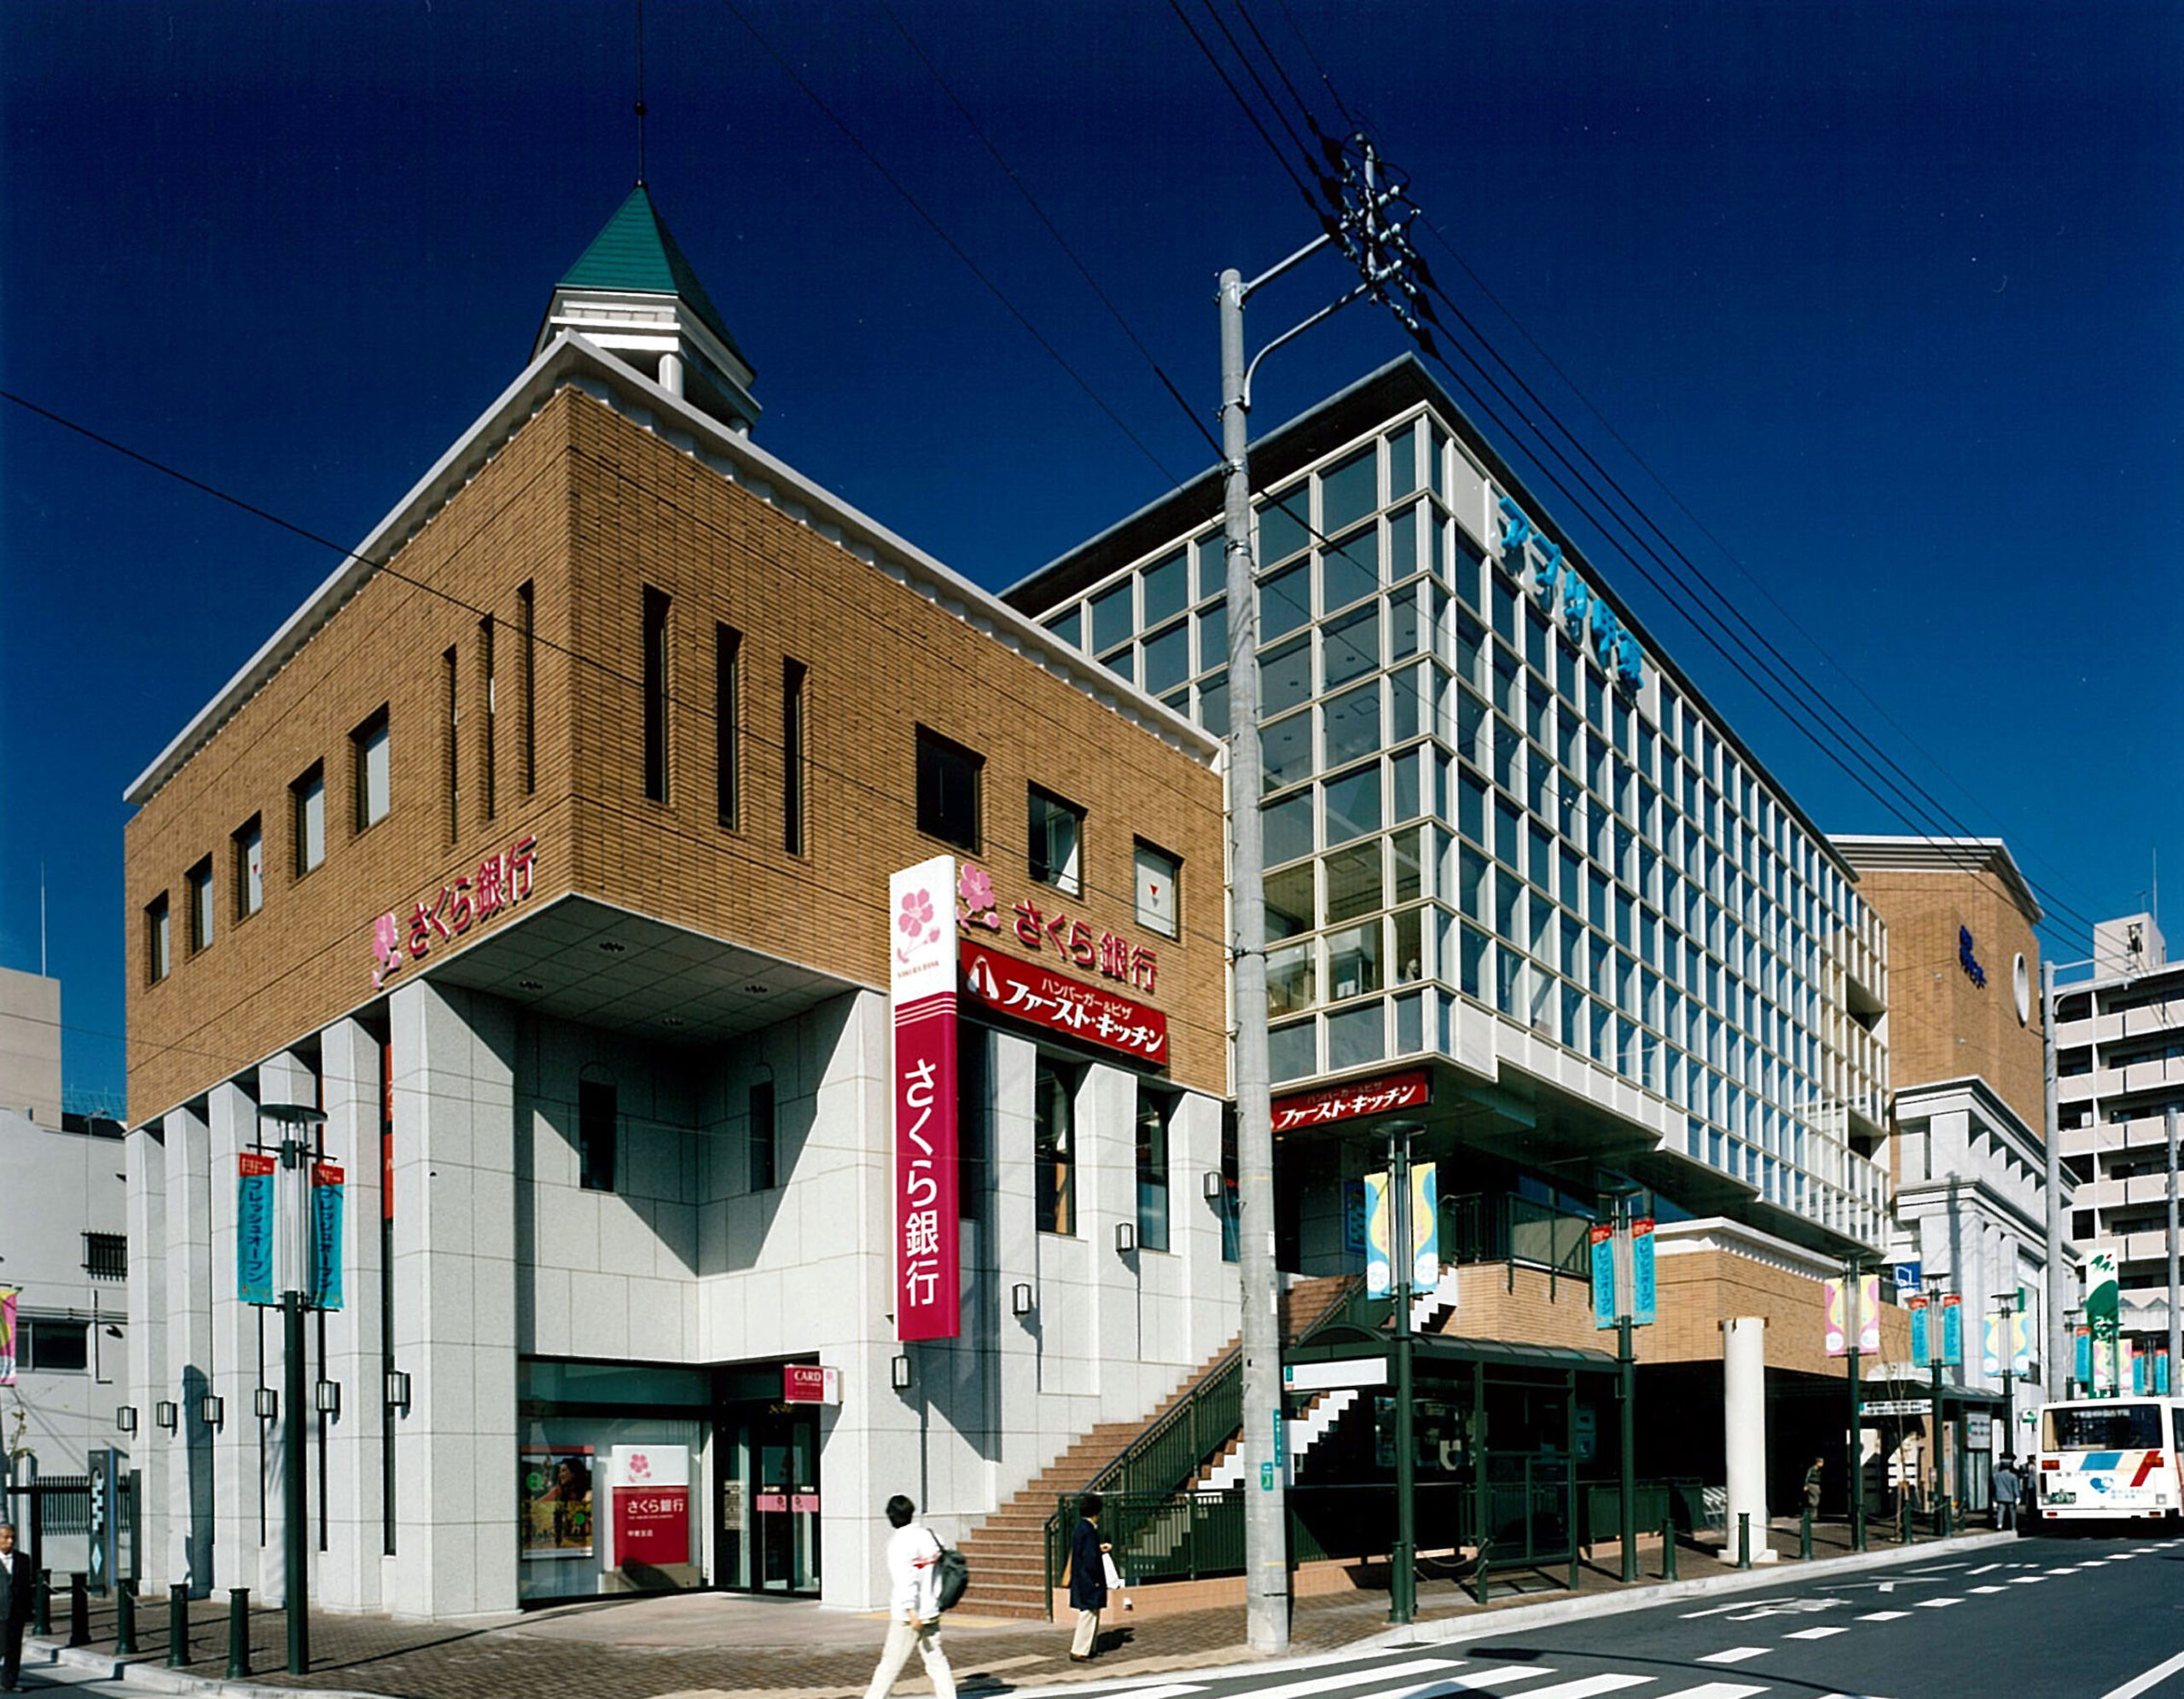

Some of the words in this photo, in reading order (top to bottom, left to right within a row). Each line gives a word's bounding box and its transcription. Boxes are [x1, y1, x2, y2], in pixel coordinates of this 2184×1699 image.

[409, 834, 537, 960] さくら銀行
[1012, 899, 1157, 992] さくら銀行
[904, 1058, 938, 1307] さくら銀行
[794, 1370, 822, 1382] CARD
[628, 1499, 684, 1514] さくら銀行
